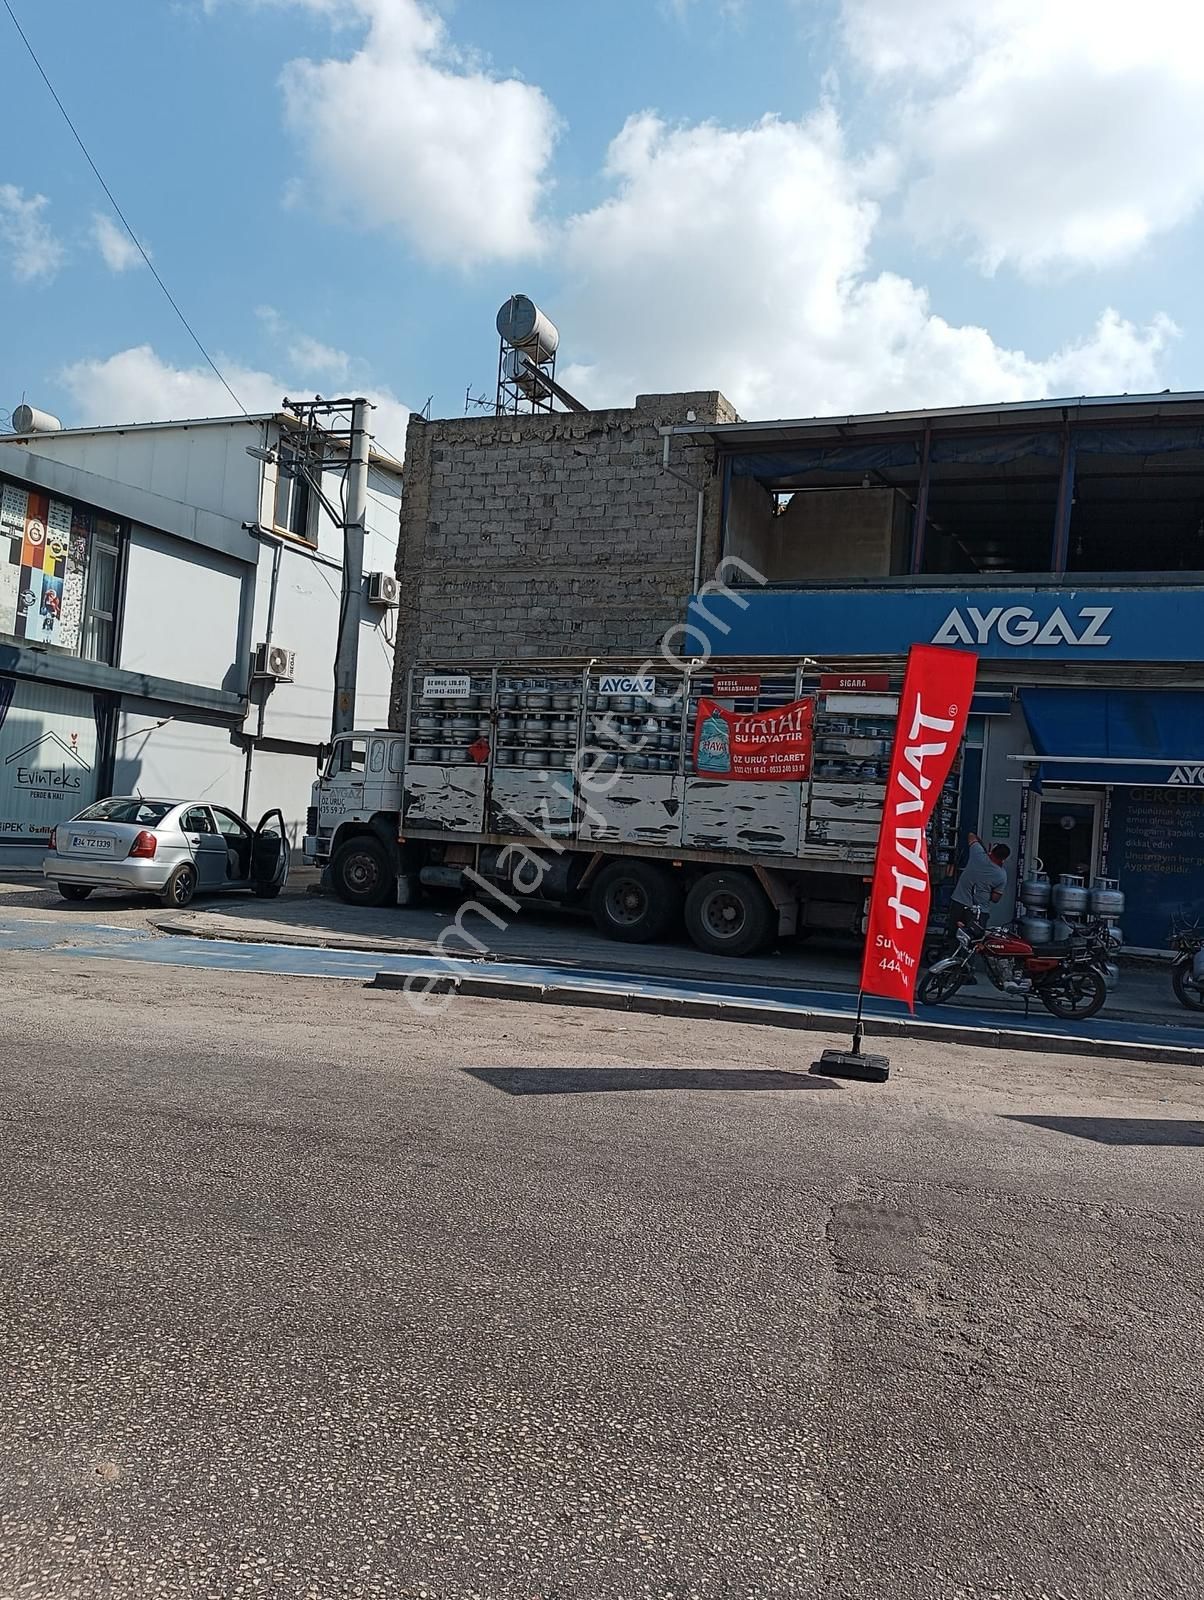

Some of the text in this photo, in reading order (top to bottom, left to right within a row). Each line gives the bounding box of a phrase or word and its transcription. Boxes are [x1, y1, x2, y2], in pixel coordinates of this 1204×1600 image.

[931, 606, 1113, 645] AYGAZ
[601, 679, 653, 692] AYGAZ
[735, 733, 802, 743] SU HAYATTIR
[733, 753, 806, 765] ÖZ URUÇ TİCARET
[17, 763, 80, 788] EvinTeks
[888, 692, 954, 929] HAYAT
[875, 934, 892, 948] Su
